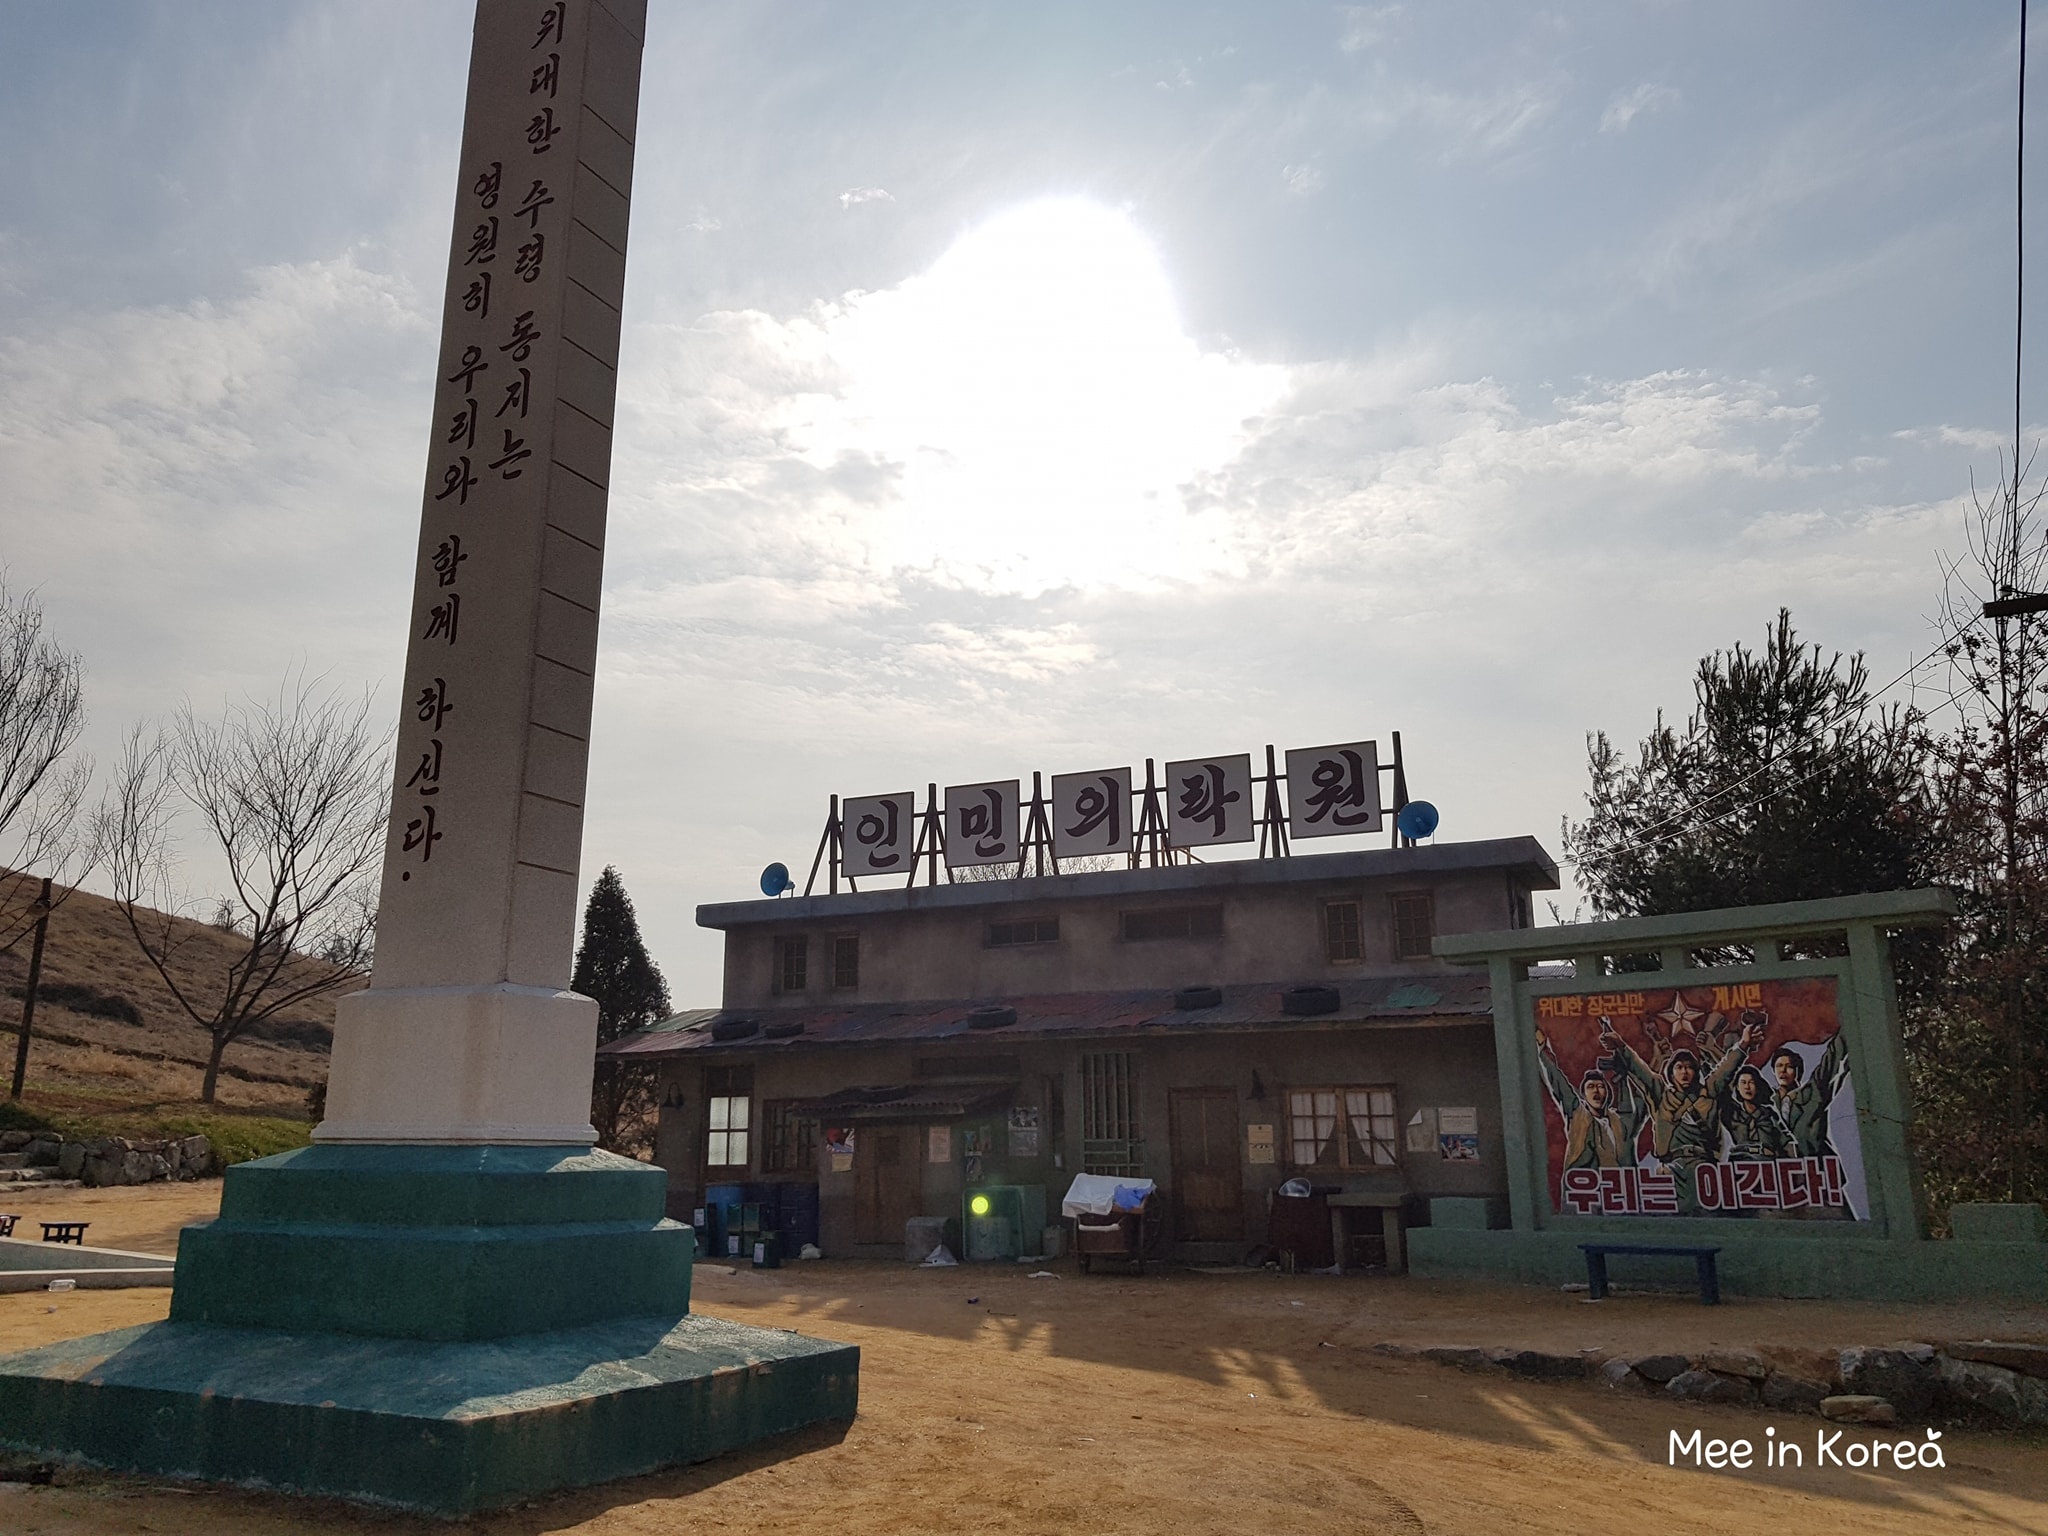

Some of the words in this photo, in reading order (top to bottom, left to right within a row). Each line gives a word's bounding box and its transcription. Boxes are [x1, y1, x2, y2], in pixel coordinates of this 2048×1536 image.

[525, 1, 566, 155] 위대한
[461, 161, 502, 319] 영원히
[513, 180, 555, 283] 수령
[436, 345, 488, 506] 우리와
[488, 310, 541, 481] 동지는
[423, 534, 468, 646] 함께
[402, 677, 453, 882] 하신다.
[1538, 996, 1584, 1017] 위대한
[1587, 992, 1646, 1016] 장군님만
[1565, 1167, 1679, 1214] 우리는
[1695, 1155, 1844, 1210] 이긴다!
